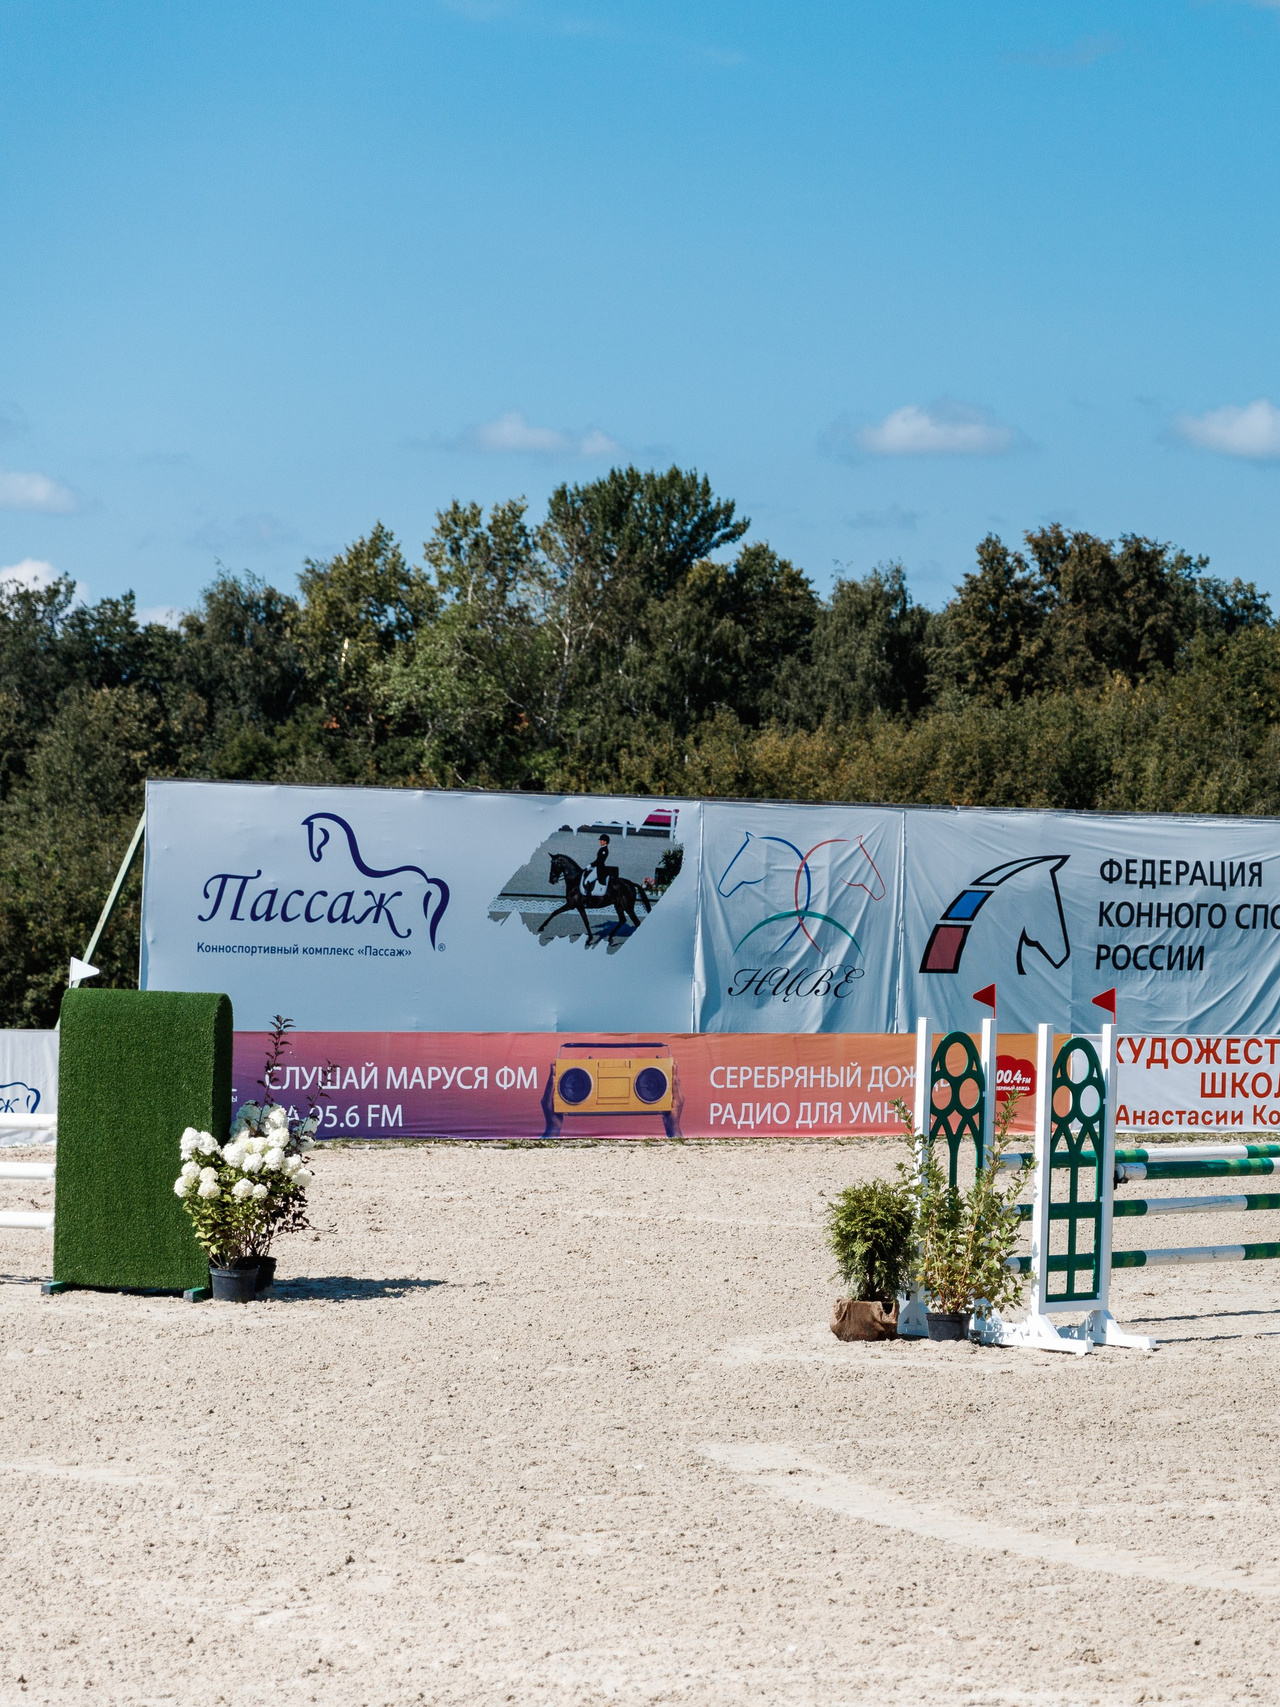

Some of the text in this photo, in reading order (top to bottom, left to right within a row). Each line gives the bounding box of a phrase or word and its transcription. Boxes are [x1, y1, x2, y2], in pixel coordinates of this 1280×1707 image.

[1099, 858, 1263, 891] ФЕДЕРАЦИЯ
[197, 869, 412, 939] Пассаж
[1098, 901, 1227, 929] КОННОГО
[196, 942, 412, 957] Конноспортивный комплекс «Пассаж»
[1095, 944, 1205, 971] РОССИИ
[265, 1062, 538, 1090] СЛУШАЙ МАРУСЯ ФМ
[710, 1062, 862, 1088] СЕРЕБРЯНЫЙ
[368, 1105, 403, 1128] FM
[709, 1102, 790, 1129] РАДИО
[795, 1102, 842, 1128] ДЛЯ
[1116, 1105, 1244, 1125] Анастасии
